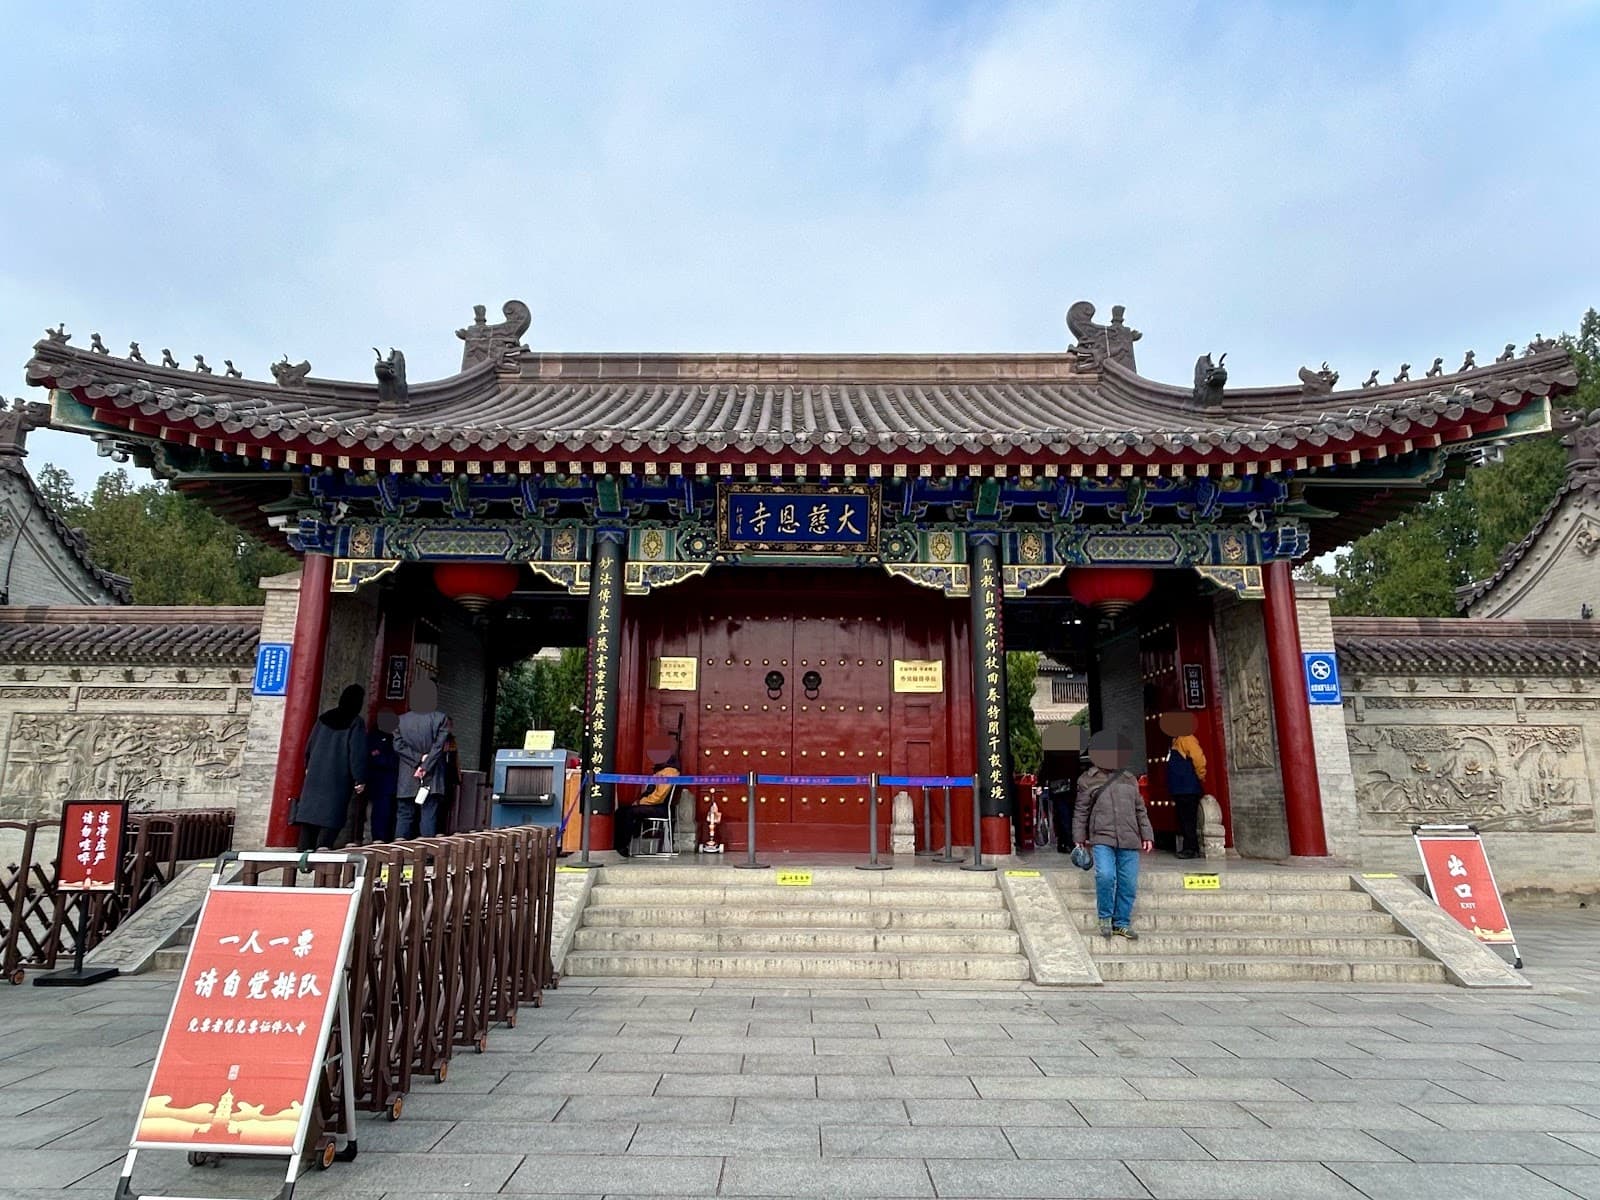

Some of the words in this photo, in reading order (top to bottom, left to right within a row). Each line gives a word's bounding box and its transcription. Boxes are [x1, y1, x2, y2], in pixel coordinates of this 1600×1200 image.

[749, 502, 862, 535] 大慈恩寺
[392, 670, 402, 689] 入口
[1189, 679, 1199, 697] 出口
[77, 810, 95, 865] 请勿喧哗
[1447, 854, 1472, 898] 出口
[219, 928, 315, 958] 一人一票
[194, 967, 322, 1000] 请自觉排队
[187, 1016, 307, 1036] 免票者凭免票证件入寺
